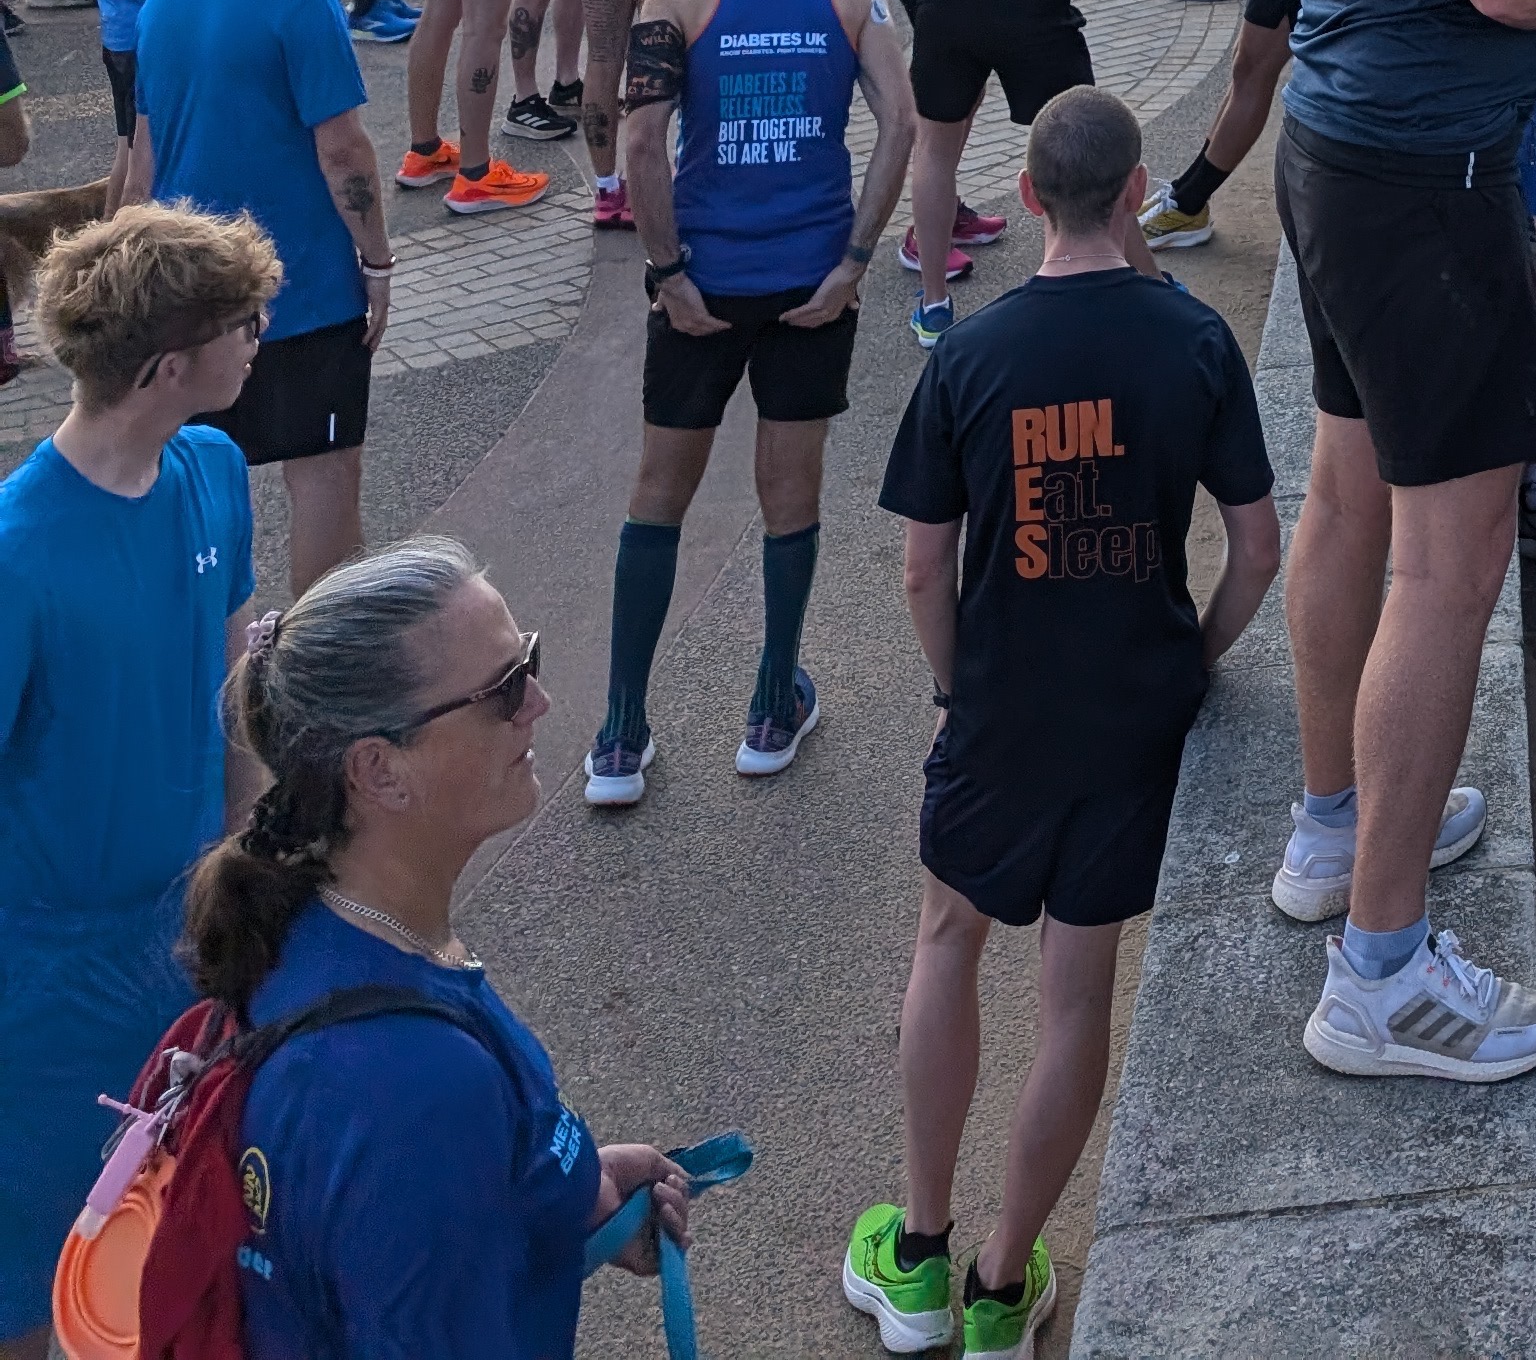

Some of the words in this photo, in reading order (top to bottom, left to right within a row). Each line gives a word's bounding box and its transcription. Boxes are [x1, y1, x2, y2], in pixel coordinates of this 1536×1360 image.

[805, 32, 828, 47] UK
[720, 72, 787, 96] DIABETES
[791, 71, 807, 94] IS
[718, 119, 747, 143] BUT
[750, 116, 826, 141] TOGETHER,
[717, 142, 737, 165] SO
[740, 141, 769, 165] ARE
[773, 140, 802, 162] WE.
[1012, 398, 1125, 466] RUN.
[1014, 460, 1113, 523] Eat.
[1014, 521, 1163, 584] Sleep
